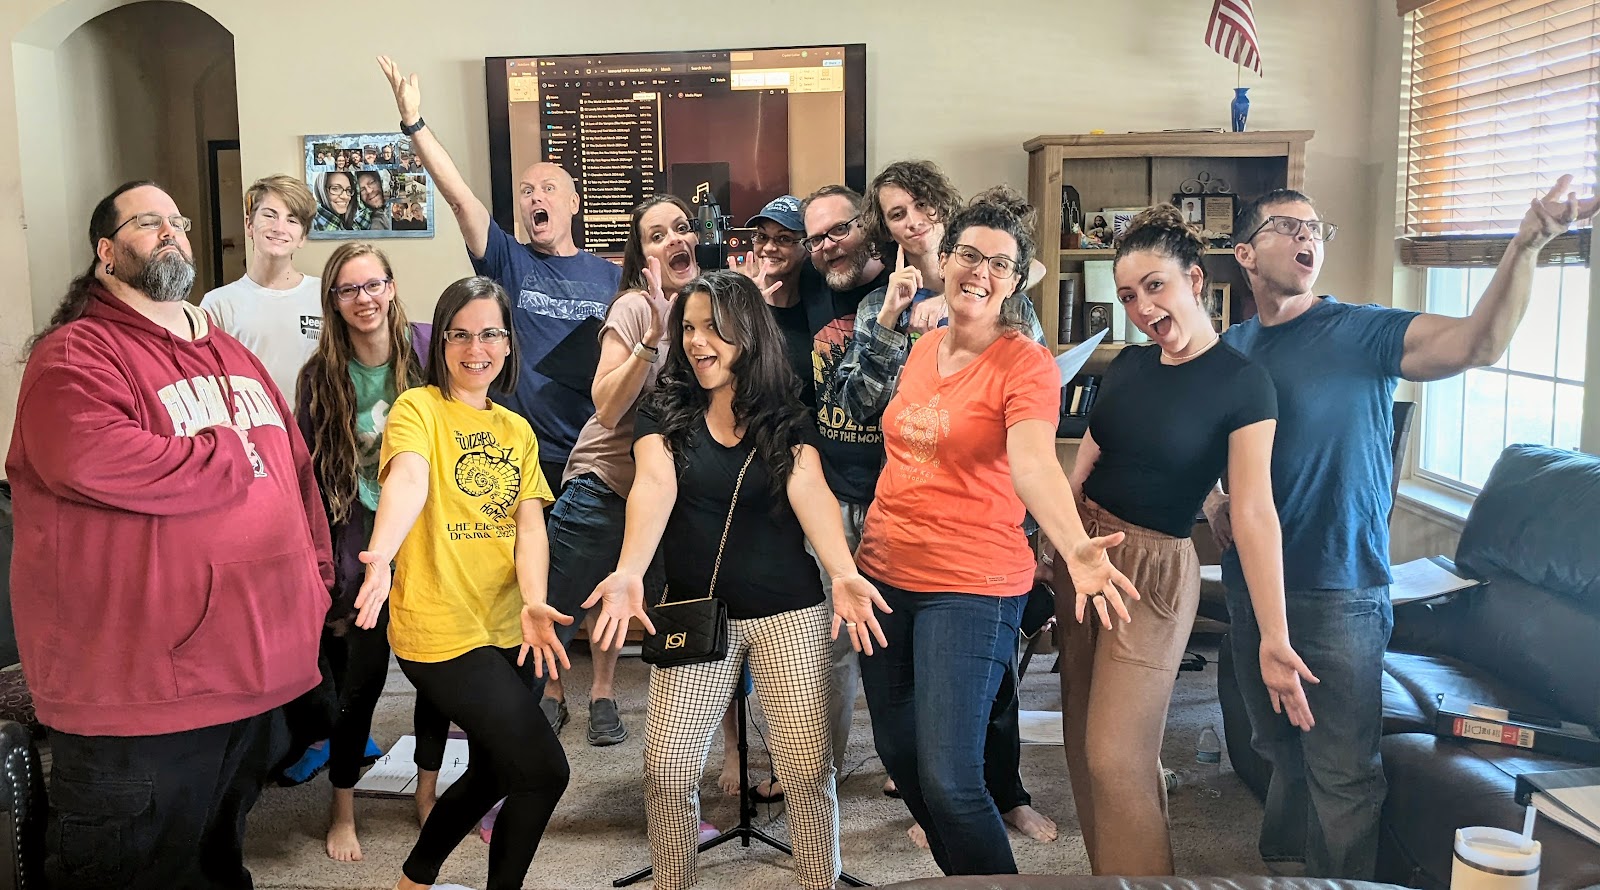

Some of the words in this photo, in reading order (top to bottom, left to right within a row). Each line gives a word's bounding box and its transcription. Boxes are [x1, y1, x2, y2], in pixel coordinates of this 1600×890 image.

[302, 316, 324, 329] Jeep
[455, 431, 497, 450] WIZARD
[827, 429, 839, 440] OF
[840, 431, 857, 443] THE
[919, 470, 936, 479] KEY
[480, 503, 507, 523] HOME
[447, 522, 470, 532] LHE
[450, 531, 492, 541] Drama
